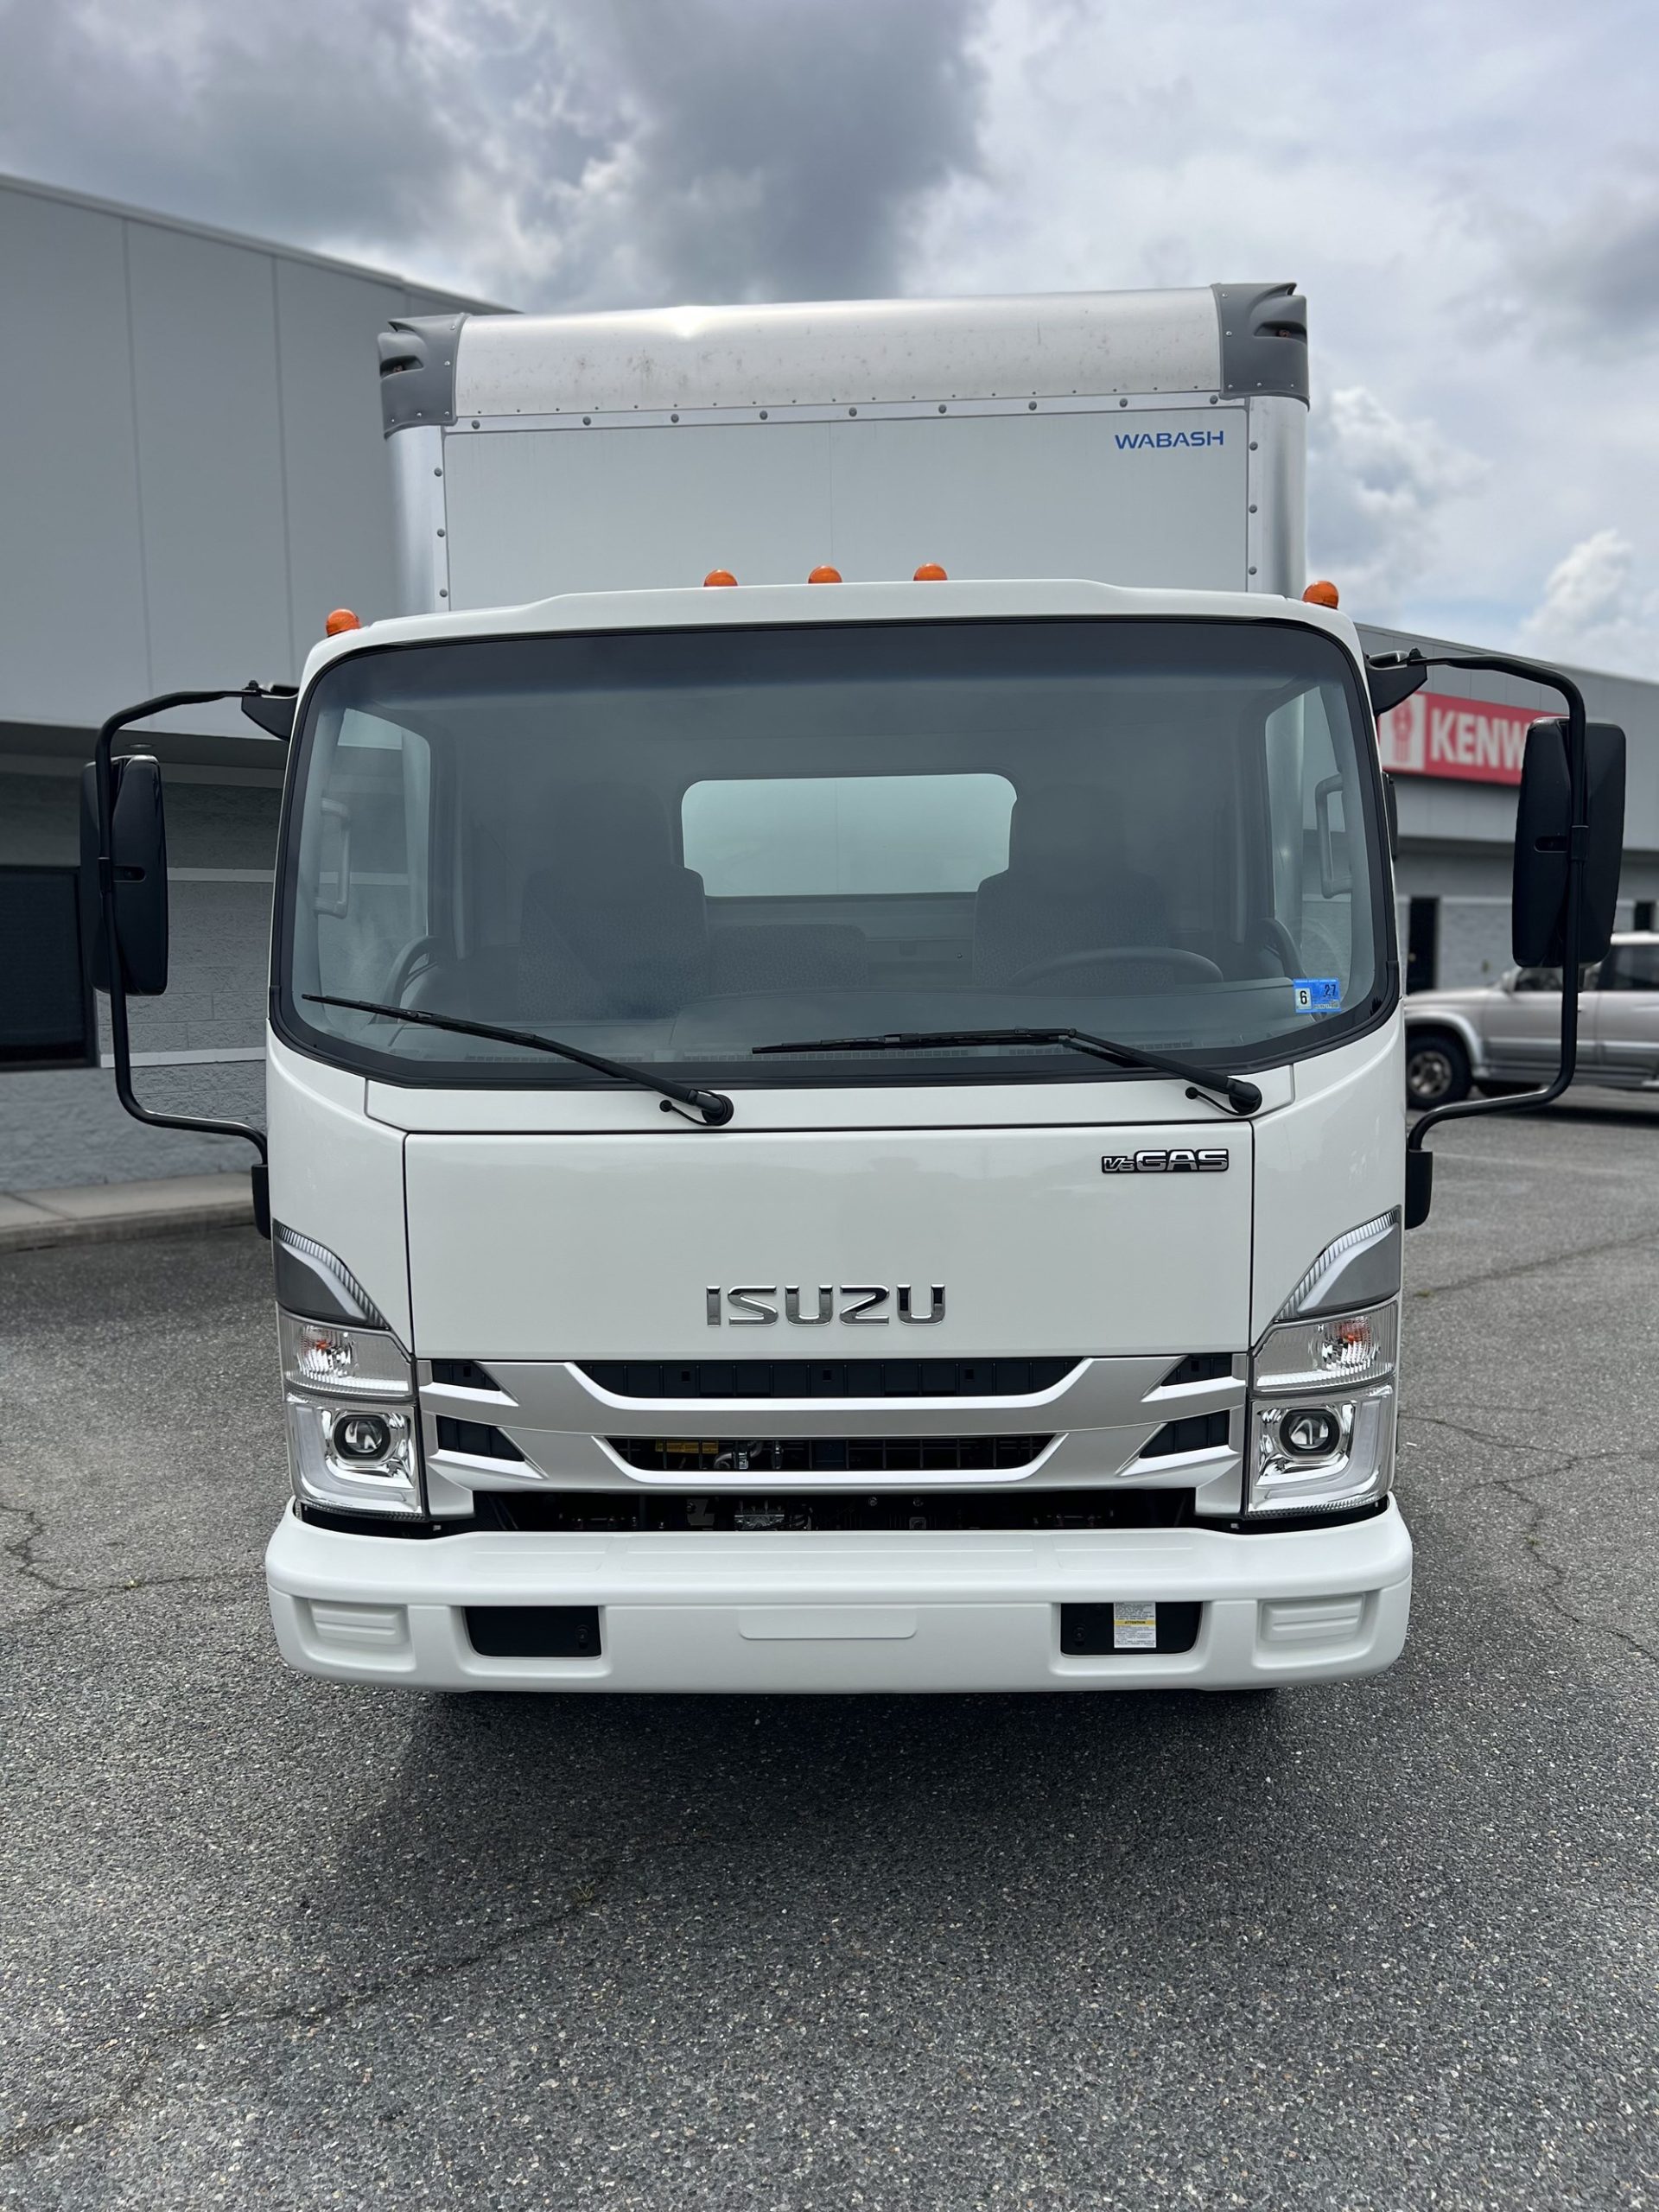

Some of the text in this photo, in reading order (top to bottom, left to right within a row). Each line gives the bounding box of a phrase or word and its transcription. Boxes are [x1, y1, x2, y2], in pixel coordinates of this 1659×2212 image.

[1115, 430, 1224, 449] WABASH
[1300, 990, 1307, 1005] 6
[1324, 983, 1337, 996] 27
[706, 1284, 946, 1327] ISUZU
